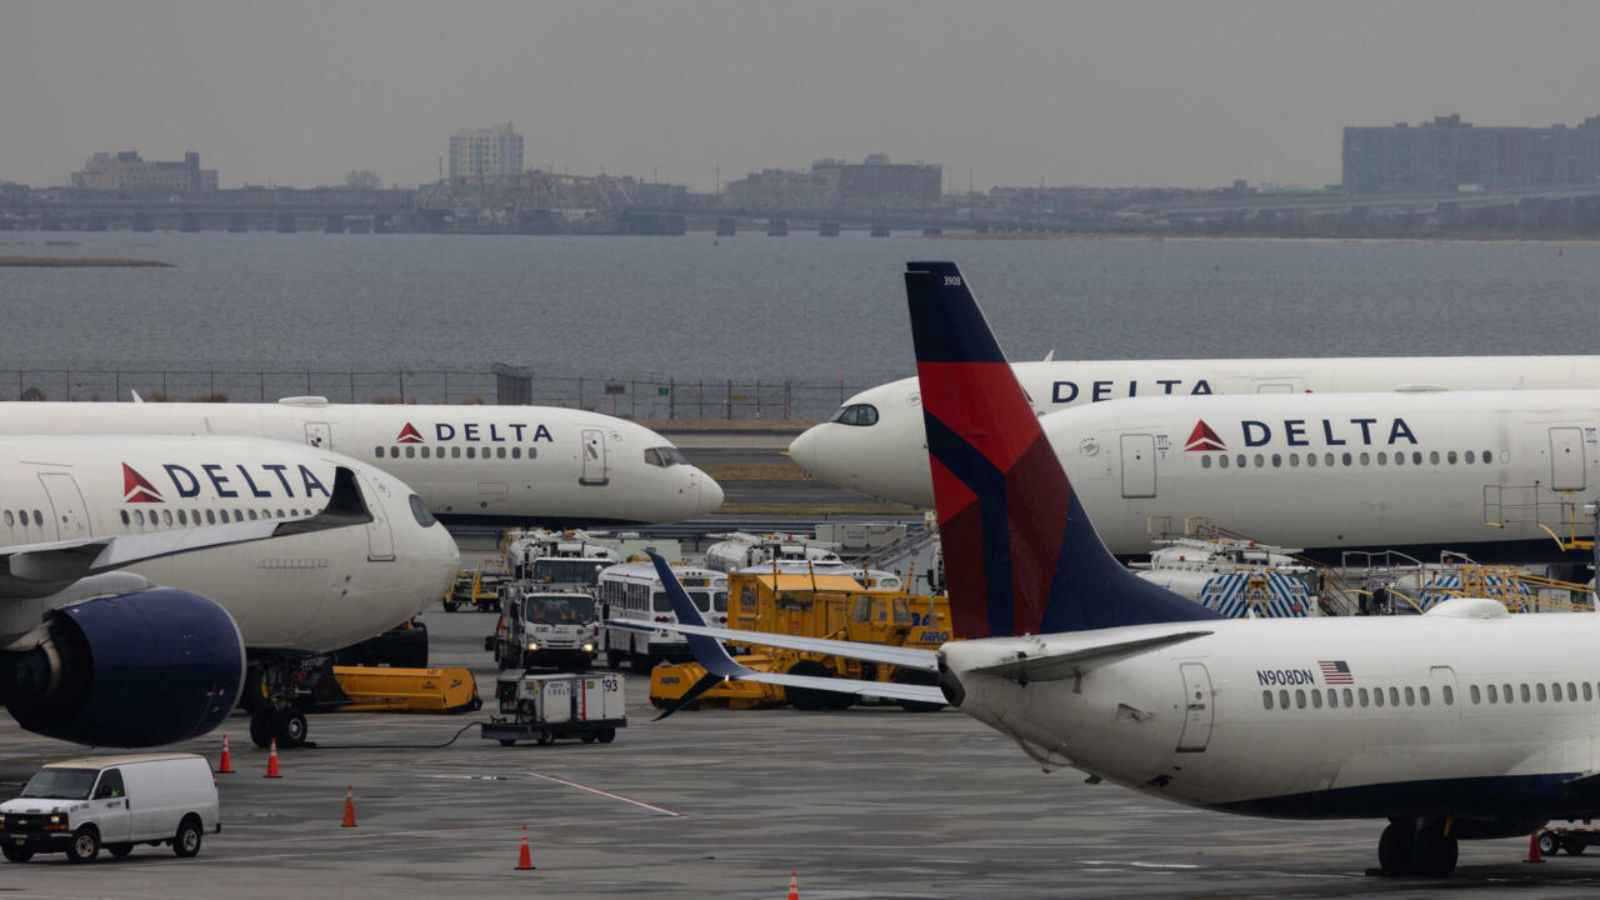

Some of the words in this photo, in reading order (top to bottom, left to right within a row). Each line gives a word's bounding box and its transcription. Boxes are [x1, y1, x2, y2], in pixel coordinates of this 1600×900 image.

[435, 423, 553, 442] DELTA
[1241, 418, 1418, 447] DELTA
[162, 464, 331, 498] DELTA
[1257, 669, 1315, 686] N908DN
